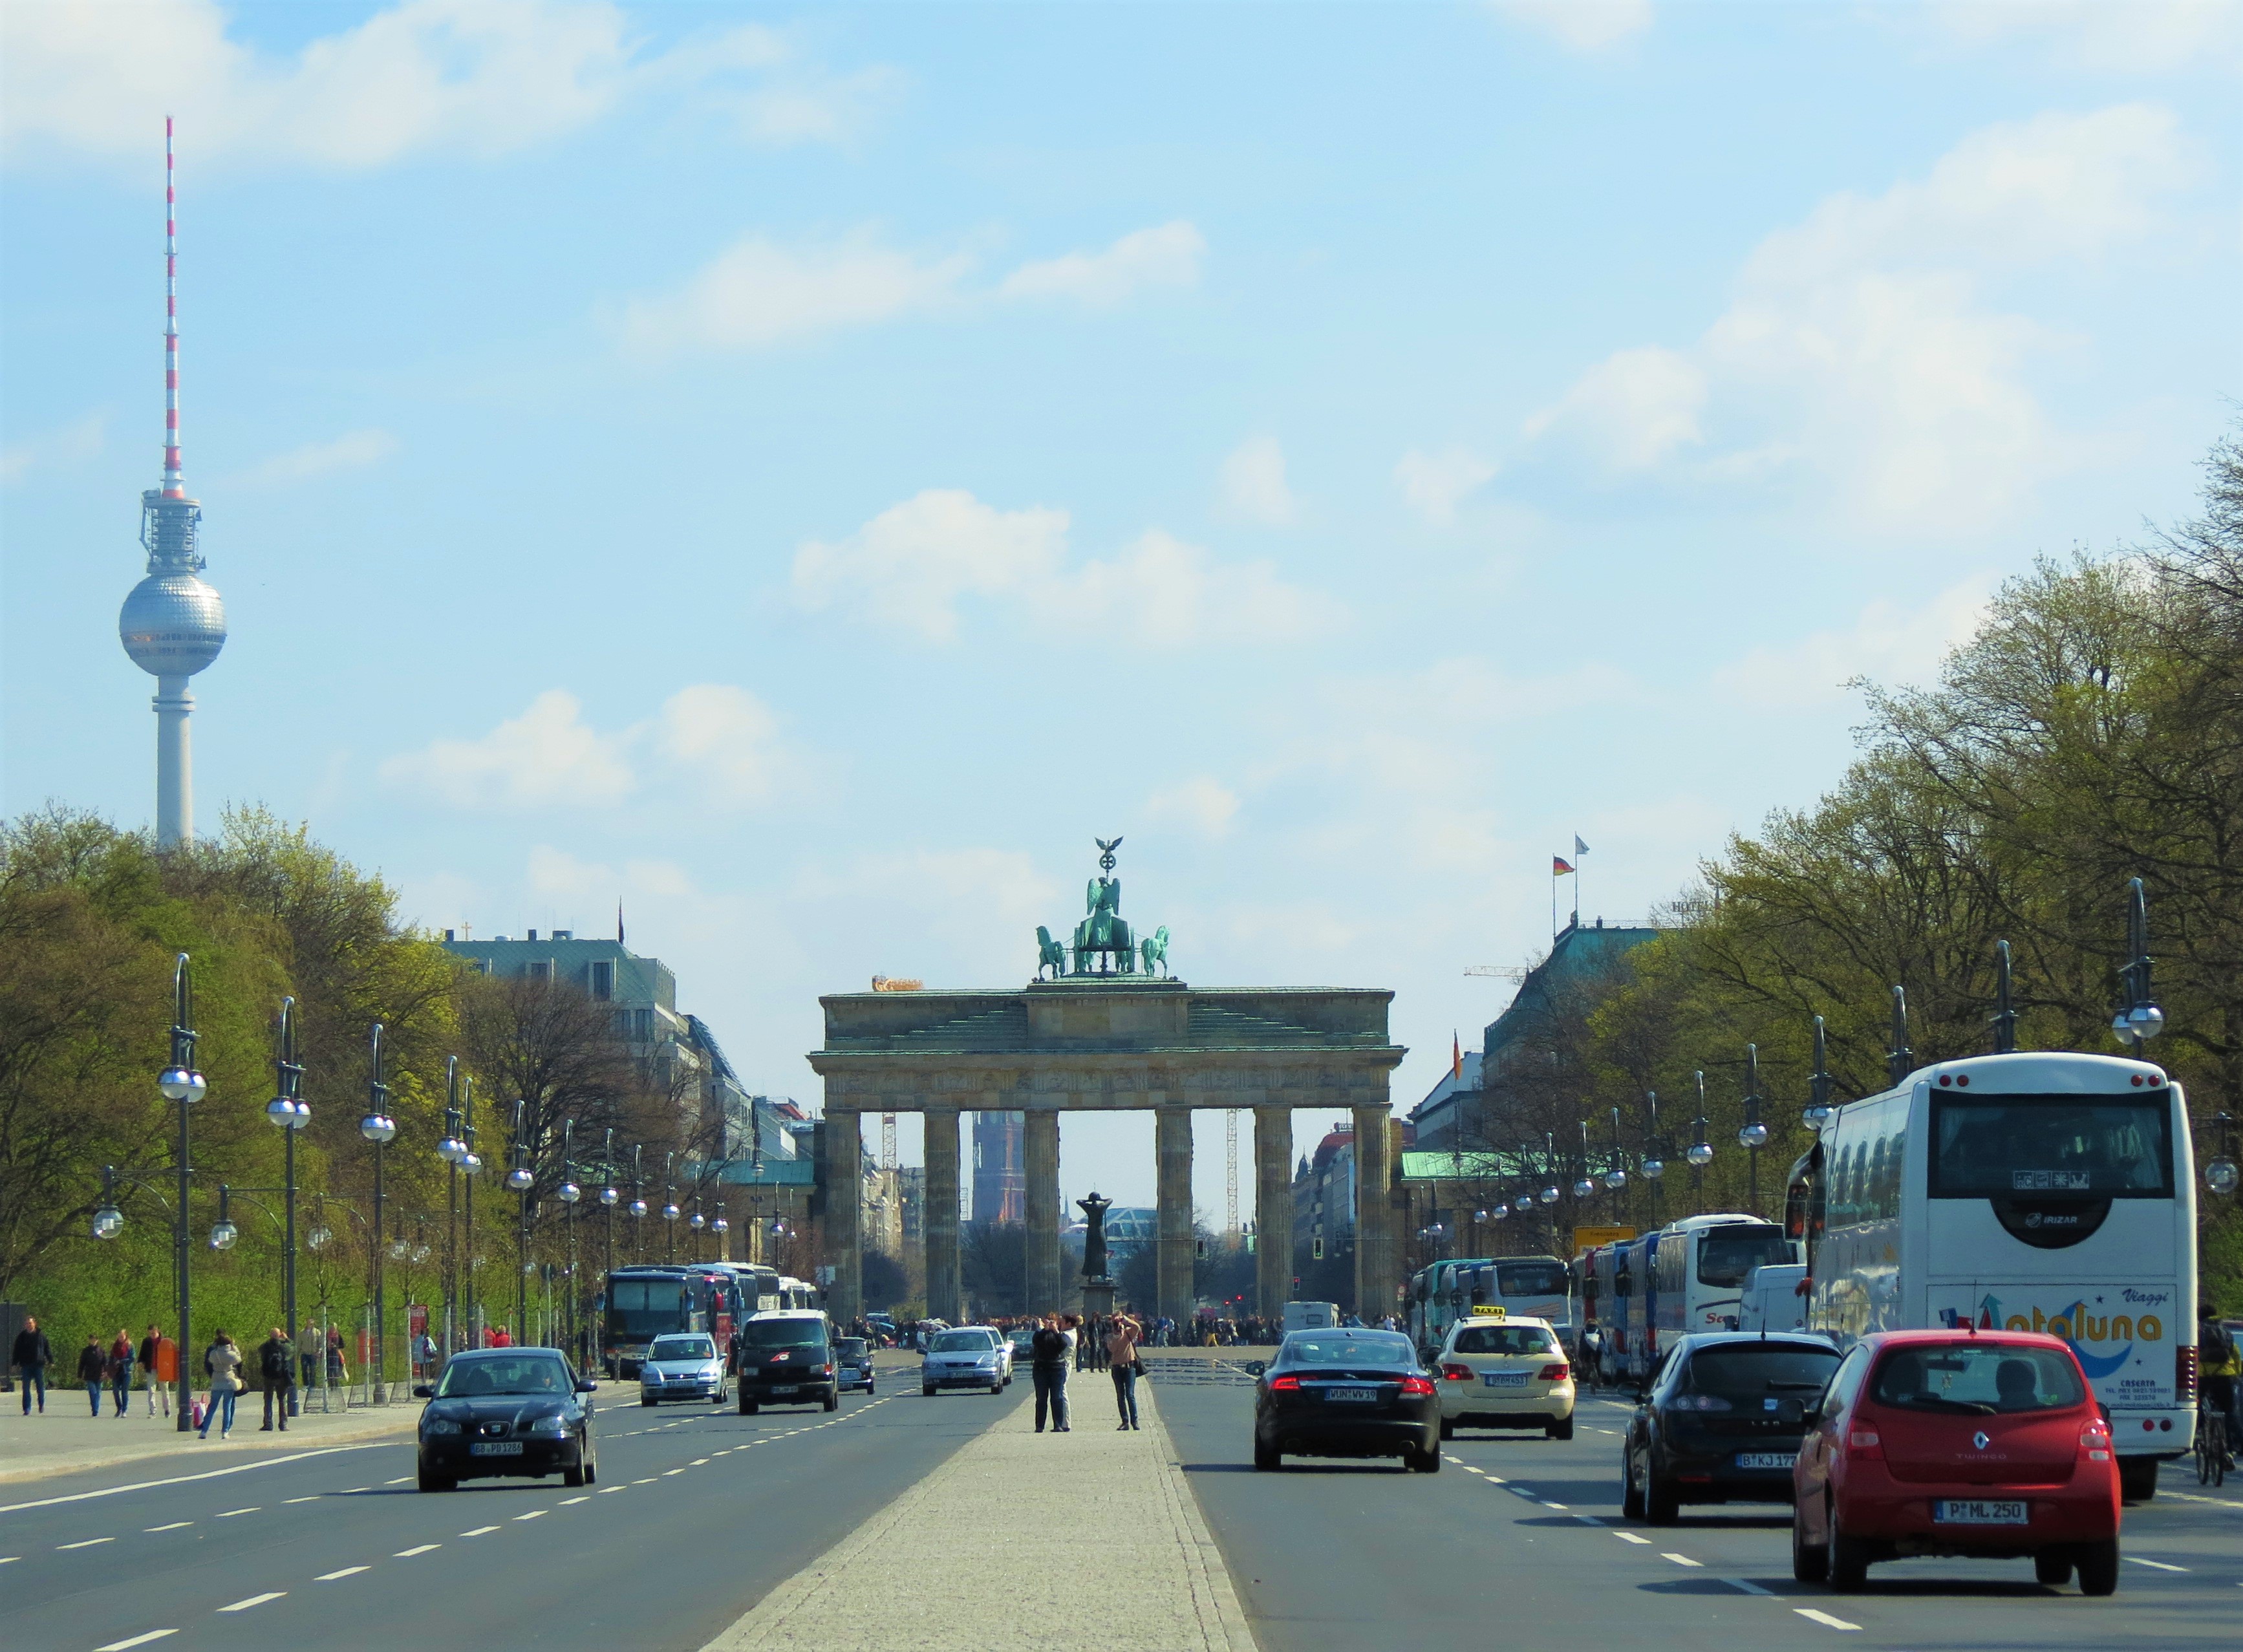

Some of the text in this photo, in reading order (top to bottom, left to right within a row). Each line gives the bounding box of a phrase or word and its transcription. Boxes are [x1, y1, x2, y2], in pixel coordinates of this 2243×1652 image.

[2122, 1288, 2169, 1306] Viaggi
[1950, 1503, 2021, 1518] P ML 250
